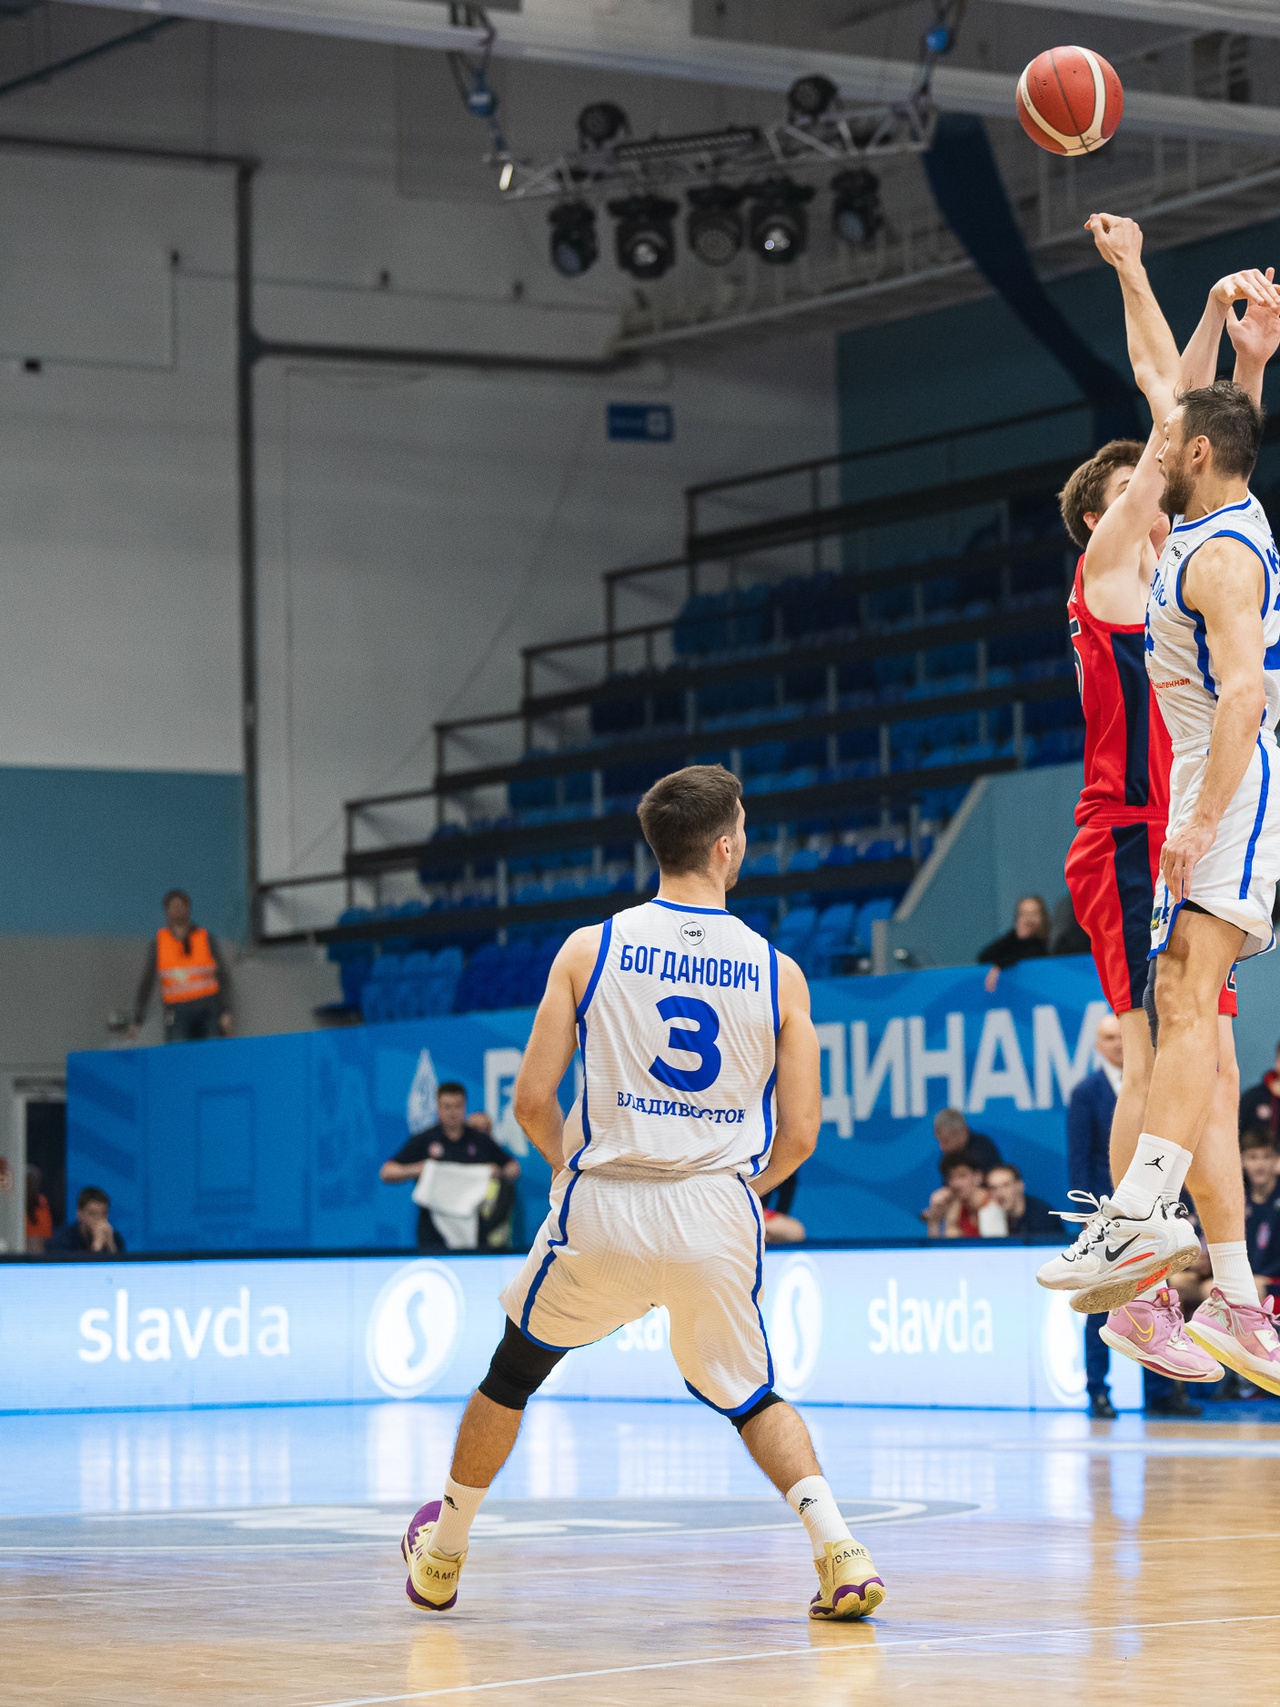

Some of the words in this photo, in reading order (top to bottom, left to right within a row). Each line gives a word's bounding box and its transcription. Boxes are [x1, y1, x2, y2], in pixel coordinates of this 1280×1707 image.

[619, 944, 760, 993] БОГДАНОВИЧ
[648, 994, 722, 1093] 3
[616, 1091, 747, 1125] ВЛАДИВОСТОК
[78, 1286, 291, 1364] slavda
[868, 1279, 994, 1354] slavda
[834, 1548, 867, 1564] DAME
